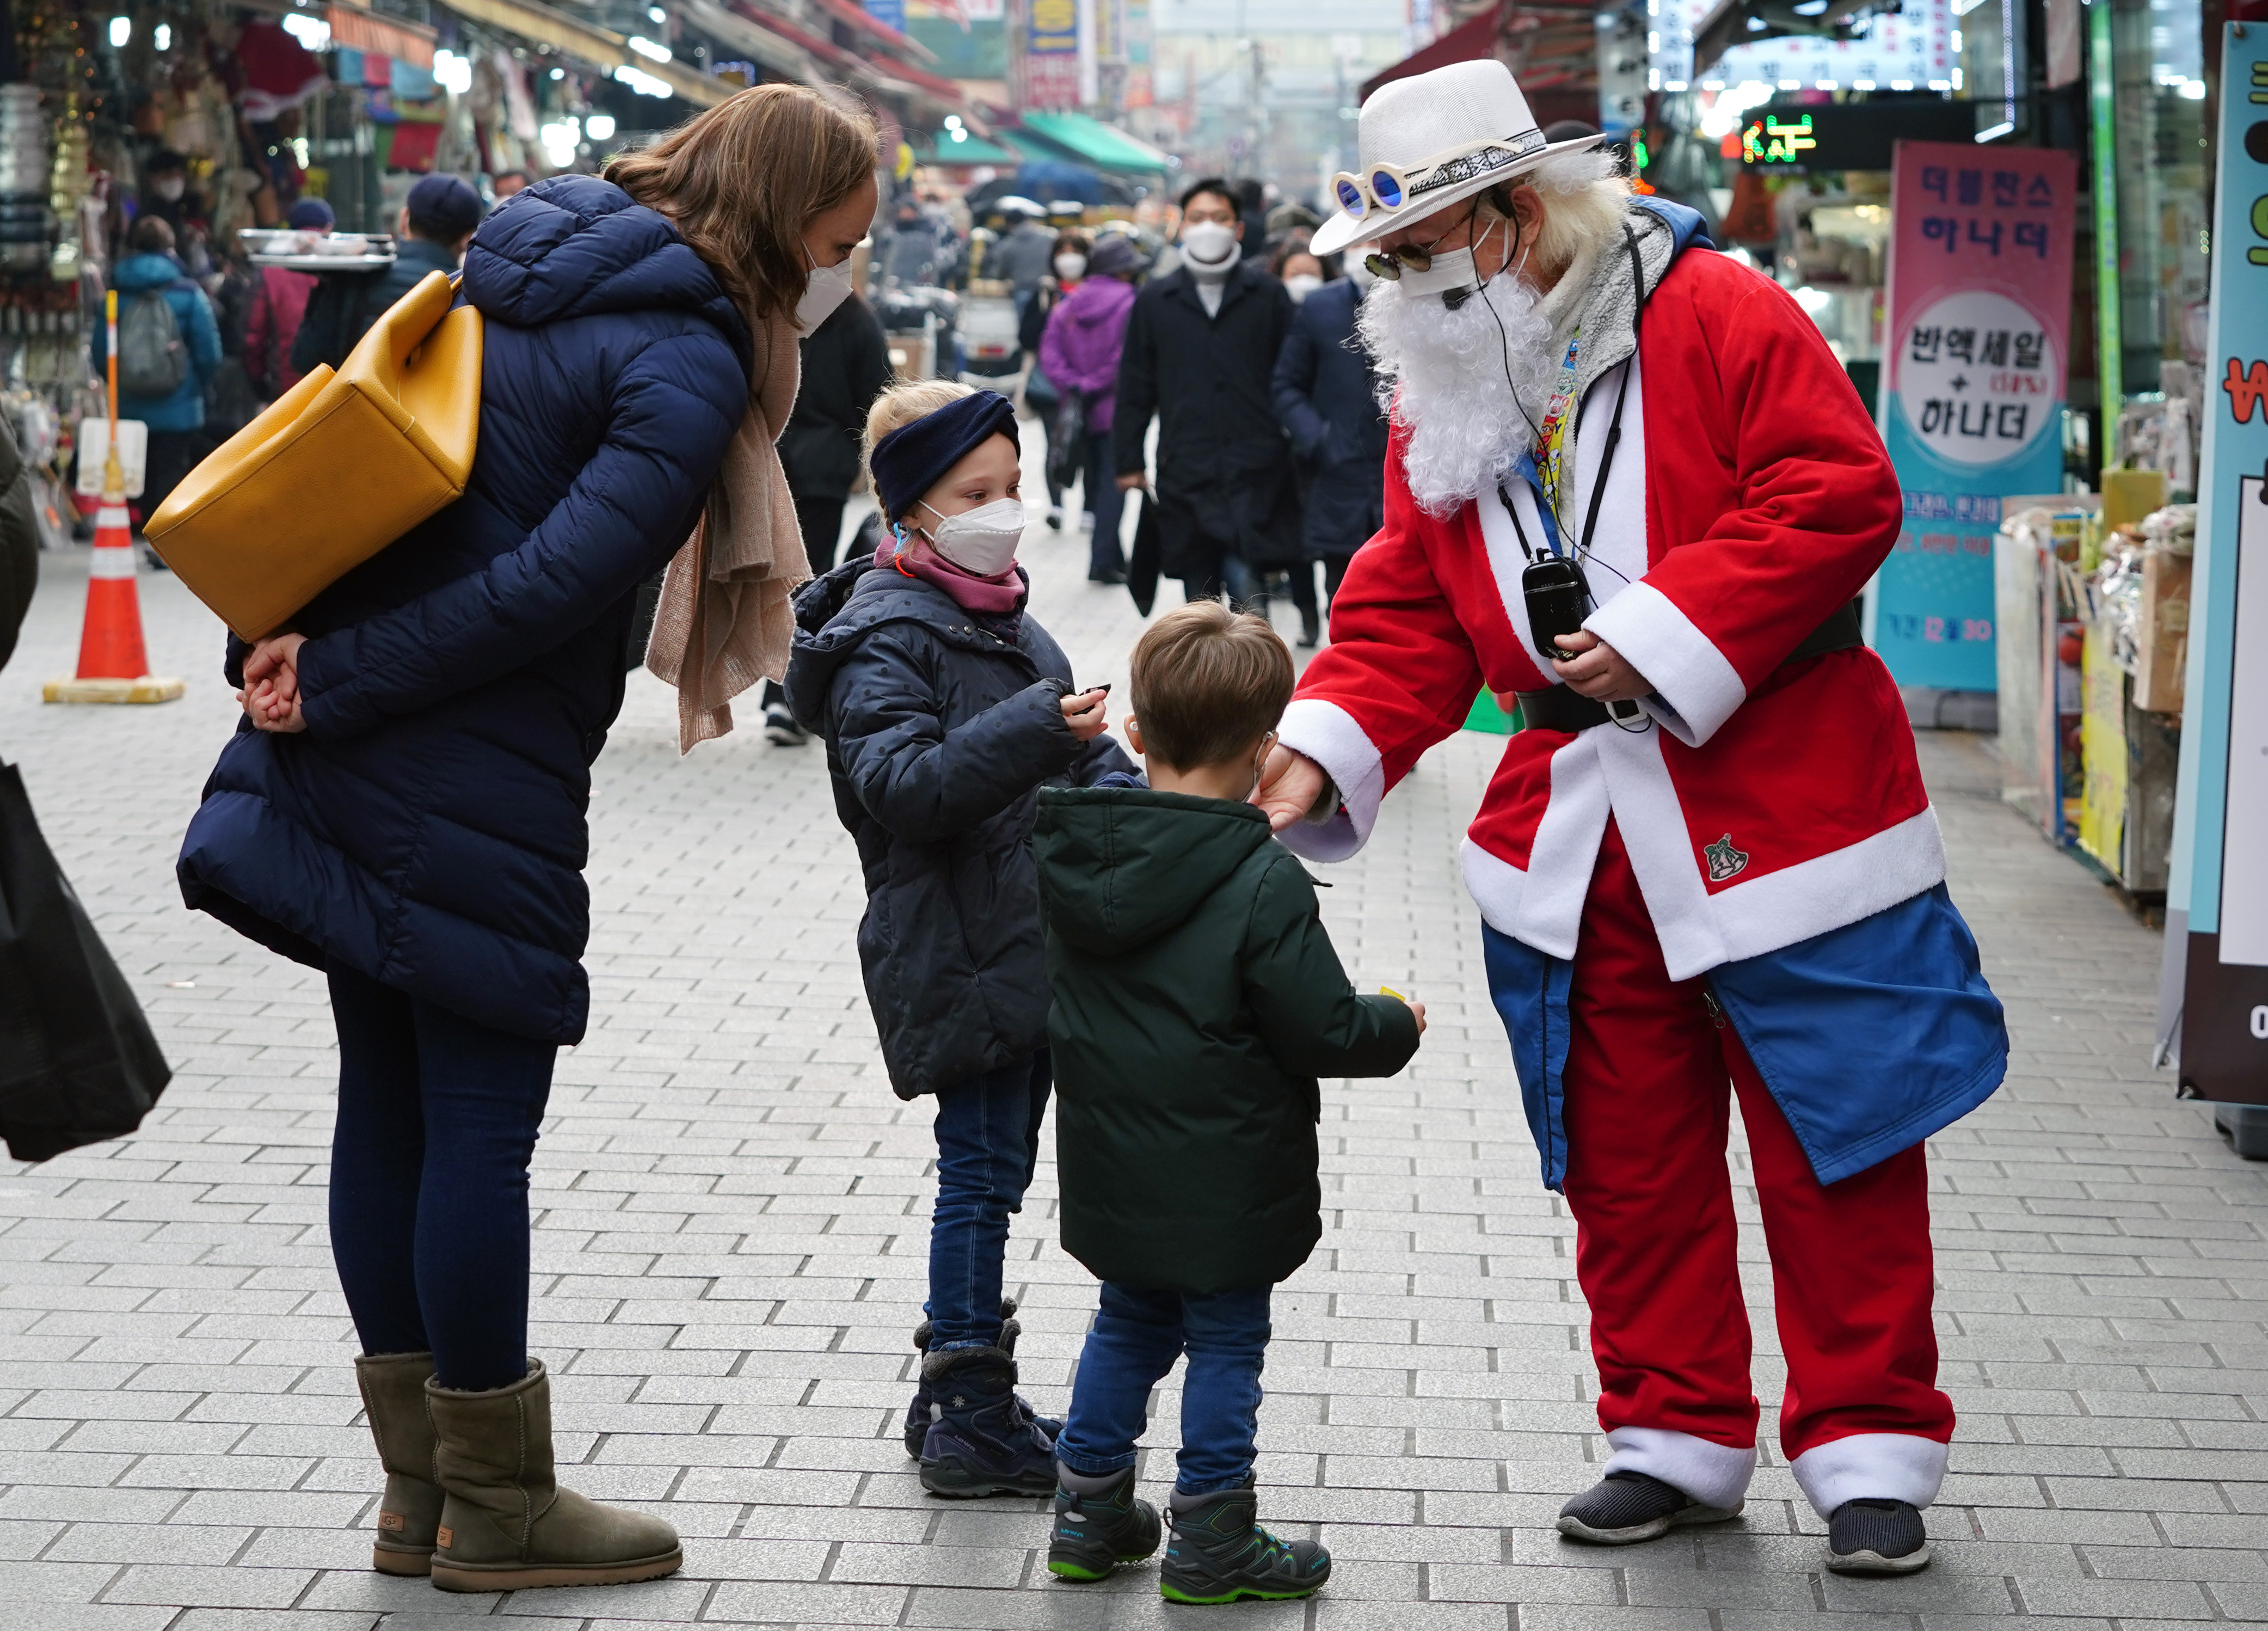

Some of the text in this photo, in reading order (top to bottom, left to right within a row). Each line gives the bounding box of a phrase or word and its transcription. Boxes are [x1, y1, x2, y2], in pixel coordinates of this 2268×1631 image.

[1921, 165, 2052, 207] 더블찬스
[1921, 216, 2049, 260] 하나더
[1912, 326, 2045, 370] 반액세일
[1920, 398, 2029, 440] 하나더
